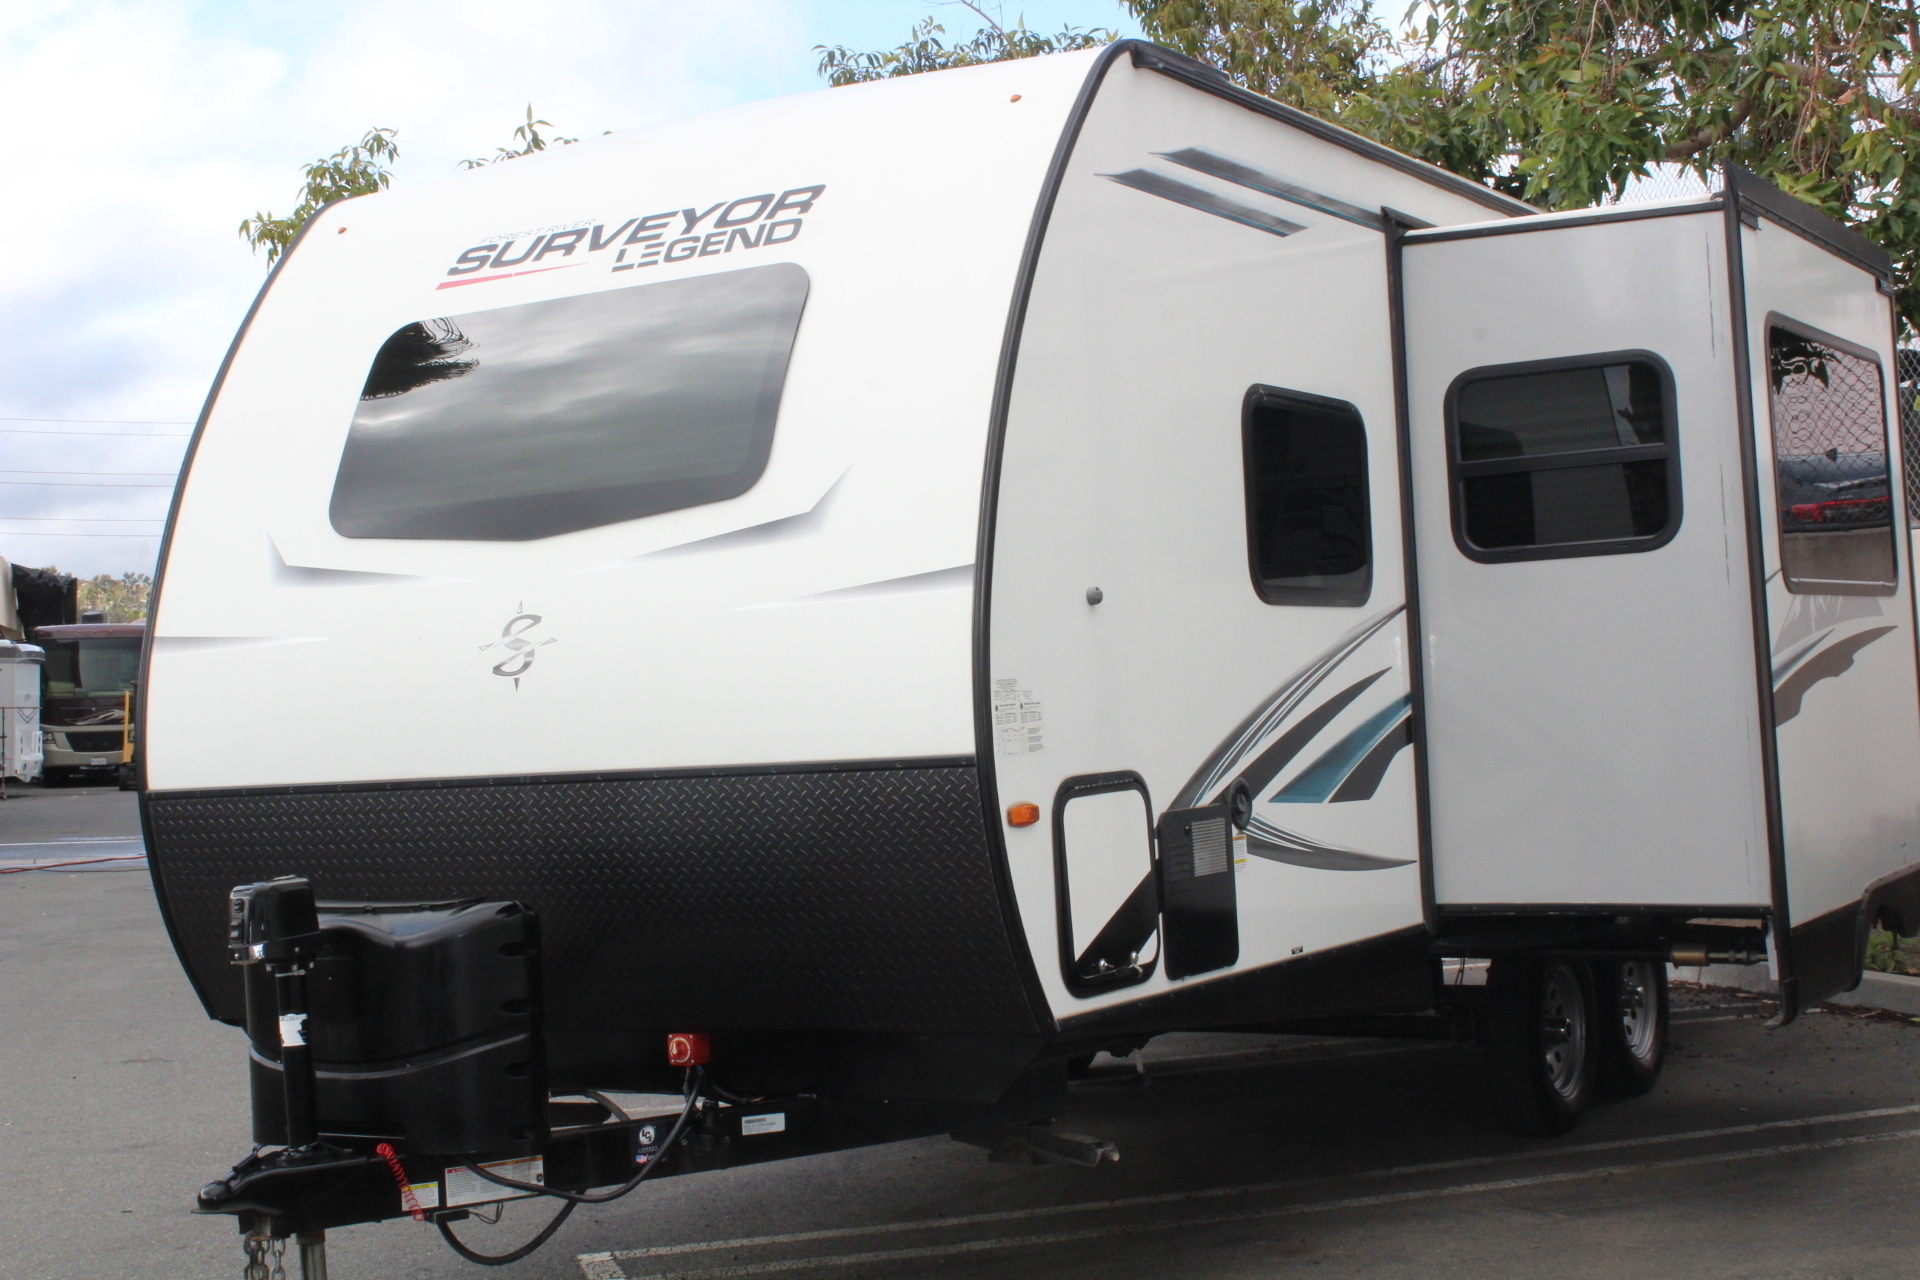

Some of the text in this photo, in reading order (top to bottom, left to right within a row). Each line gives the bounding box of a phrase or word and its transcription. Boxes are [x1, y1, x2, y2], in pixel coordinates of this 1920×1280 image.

[446, 184, 826, 277] SURVEYOR
[479, 218, 596, 245] FOREST RIVER
[611, 218, 803, 273] LEGEND
